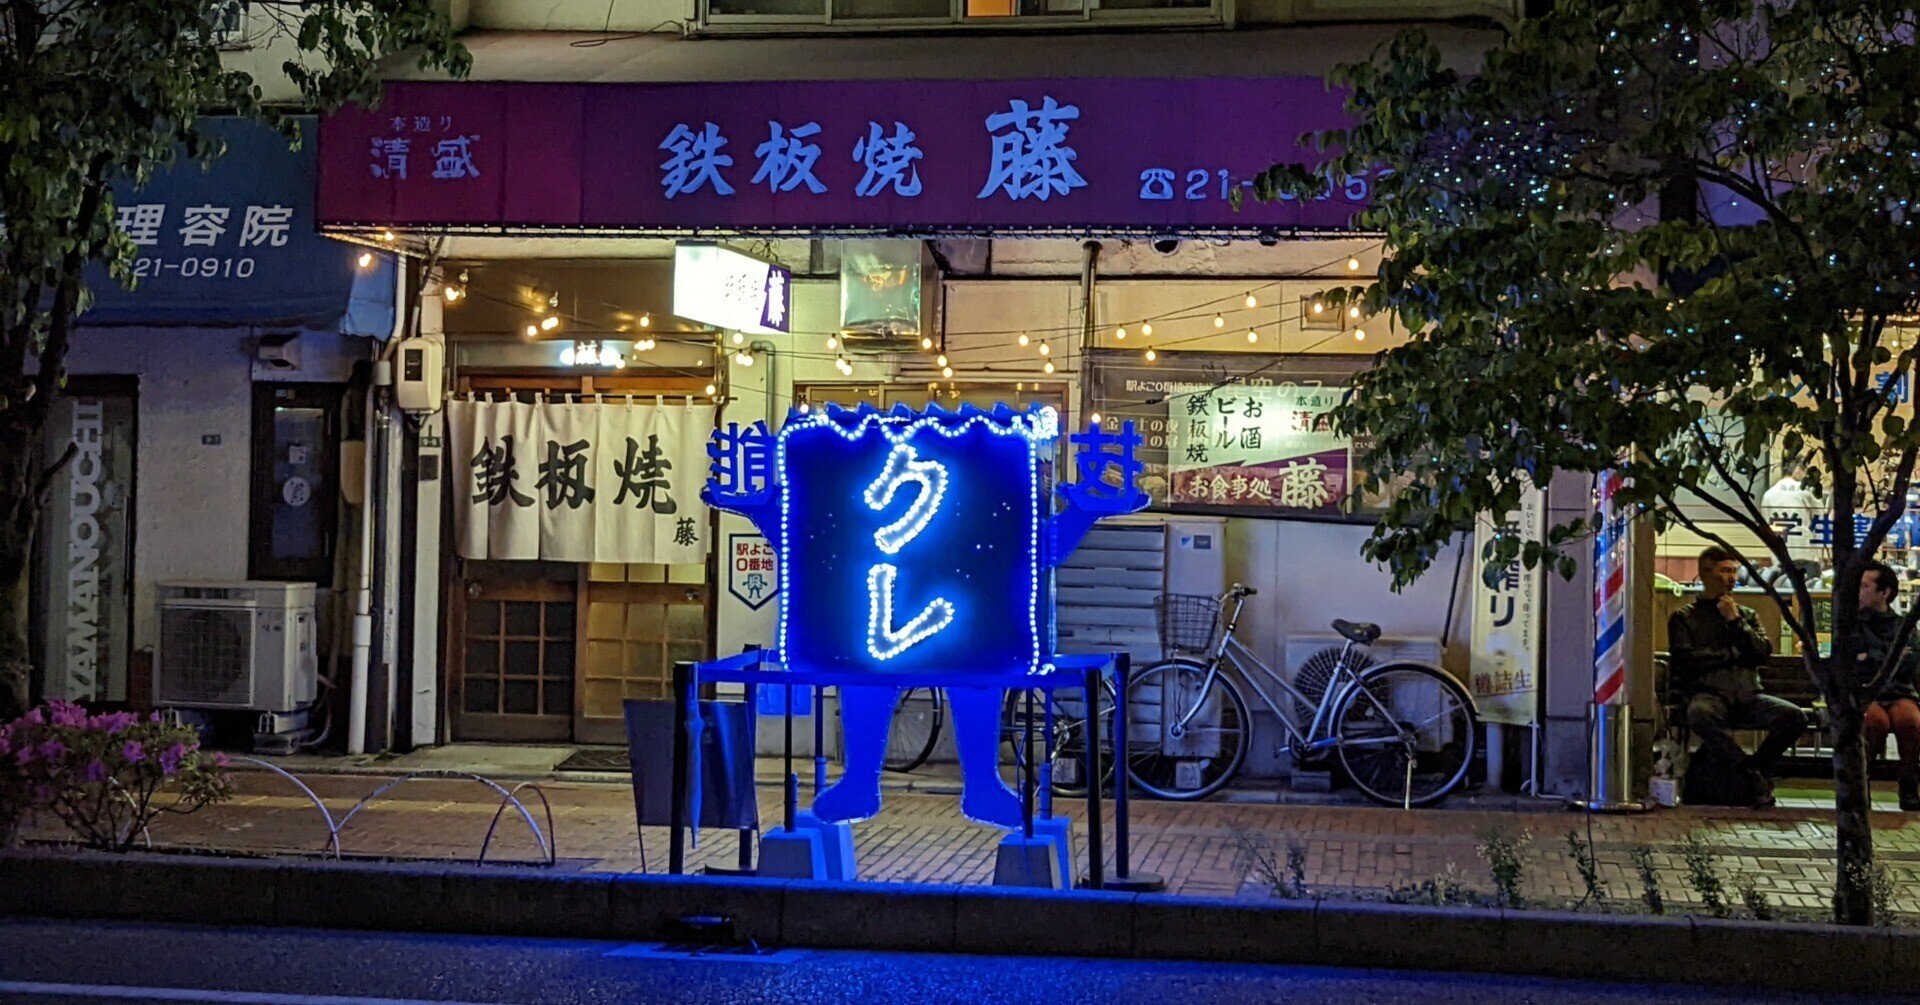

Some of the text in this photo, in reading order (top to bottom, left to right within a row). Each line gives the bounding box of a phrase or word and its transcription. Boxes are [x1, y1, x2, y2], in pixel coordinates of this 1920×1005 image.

[370, 134, 481, 179] 清盛
[659, 96, 1089, 201] 鉄板焼 藤
[1186, 394, 1210, 464] 鉄板焼
[1216, 397, 1237, 450] ビール
[1240, 400, 1264, 451] お酒
[470, 434, 677, 515] 鉄板焼
[1188, 457, 1329, 509] お食事処 藤
[66, 399, 103, 702] YAMANOUCHI
[673, 516, 700, 547] 藤
[736, 543, 774, 556] 駅よこ
